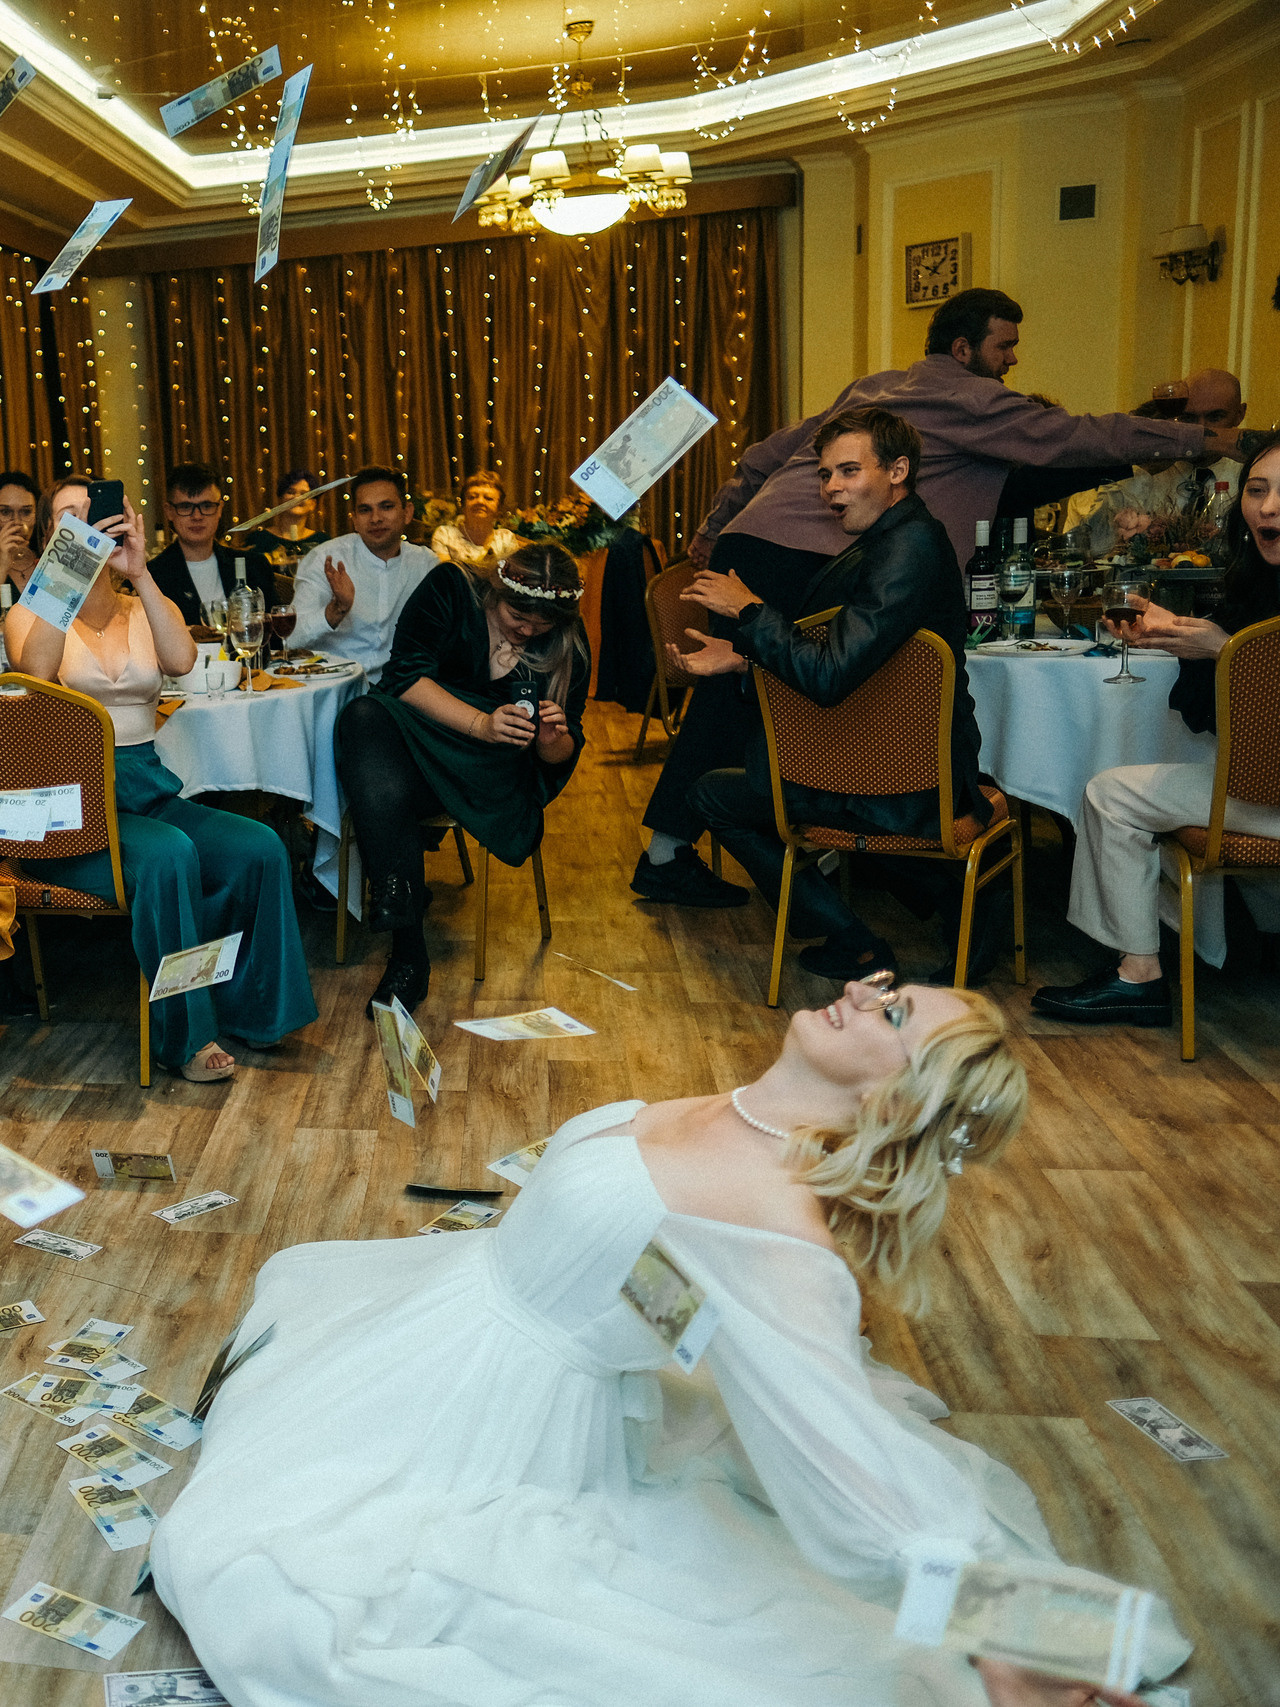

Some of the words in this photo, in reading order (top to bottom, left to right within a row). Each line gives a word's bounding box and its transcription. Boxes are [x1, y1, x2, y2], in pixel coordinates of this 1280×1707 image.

[950, 262, 958, 274] 3
[922, 286, 929, 297] 7
[931, 285, 939, 297] 6
[942, 282, 949, 295] 5
[652, 384, 674, 406] 200
[580, 460, 601, 481] 200
[48, 528, 75, 564] 200
[59, 611, 72, 627] 200
[214, 969, 230, 979] 200
[153, 987, 169, 997] 200
[81, 1347, 106, 1364] 200
[4, 1390, 20, 1399] 200
[41, 1393, 72, 1404] 200
[60, 1415, 75, 1423] 200
[69, 1443, 96, 1462] 200
[78, 1485, 99, 1508] 200
[19, 1610, 56, 1632] 200
